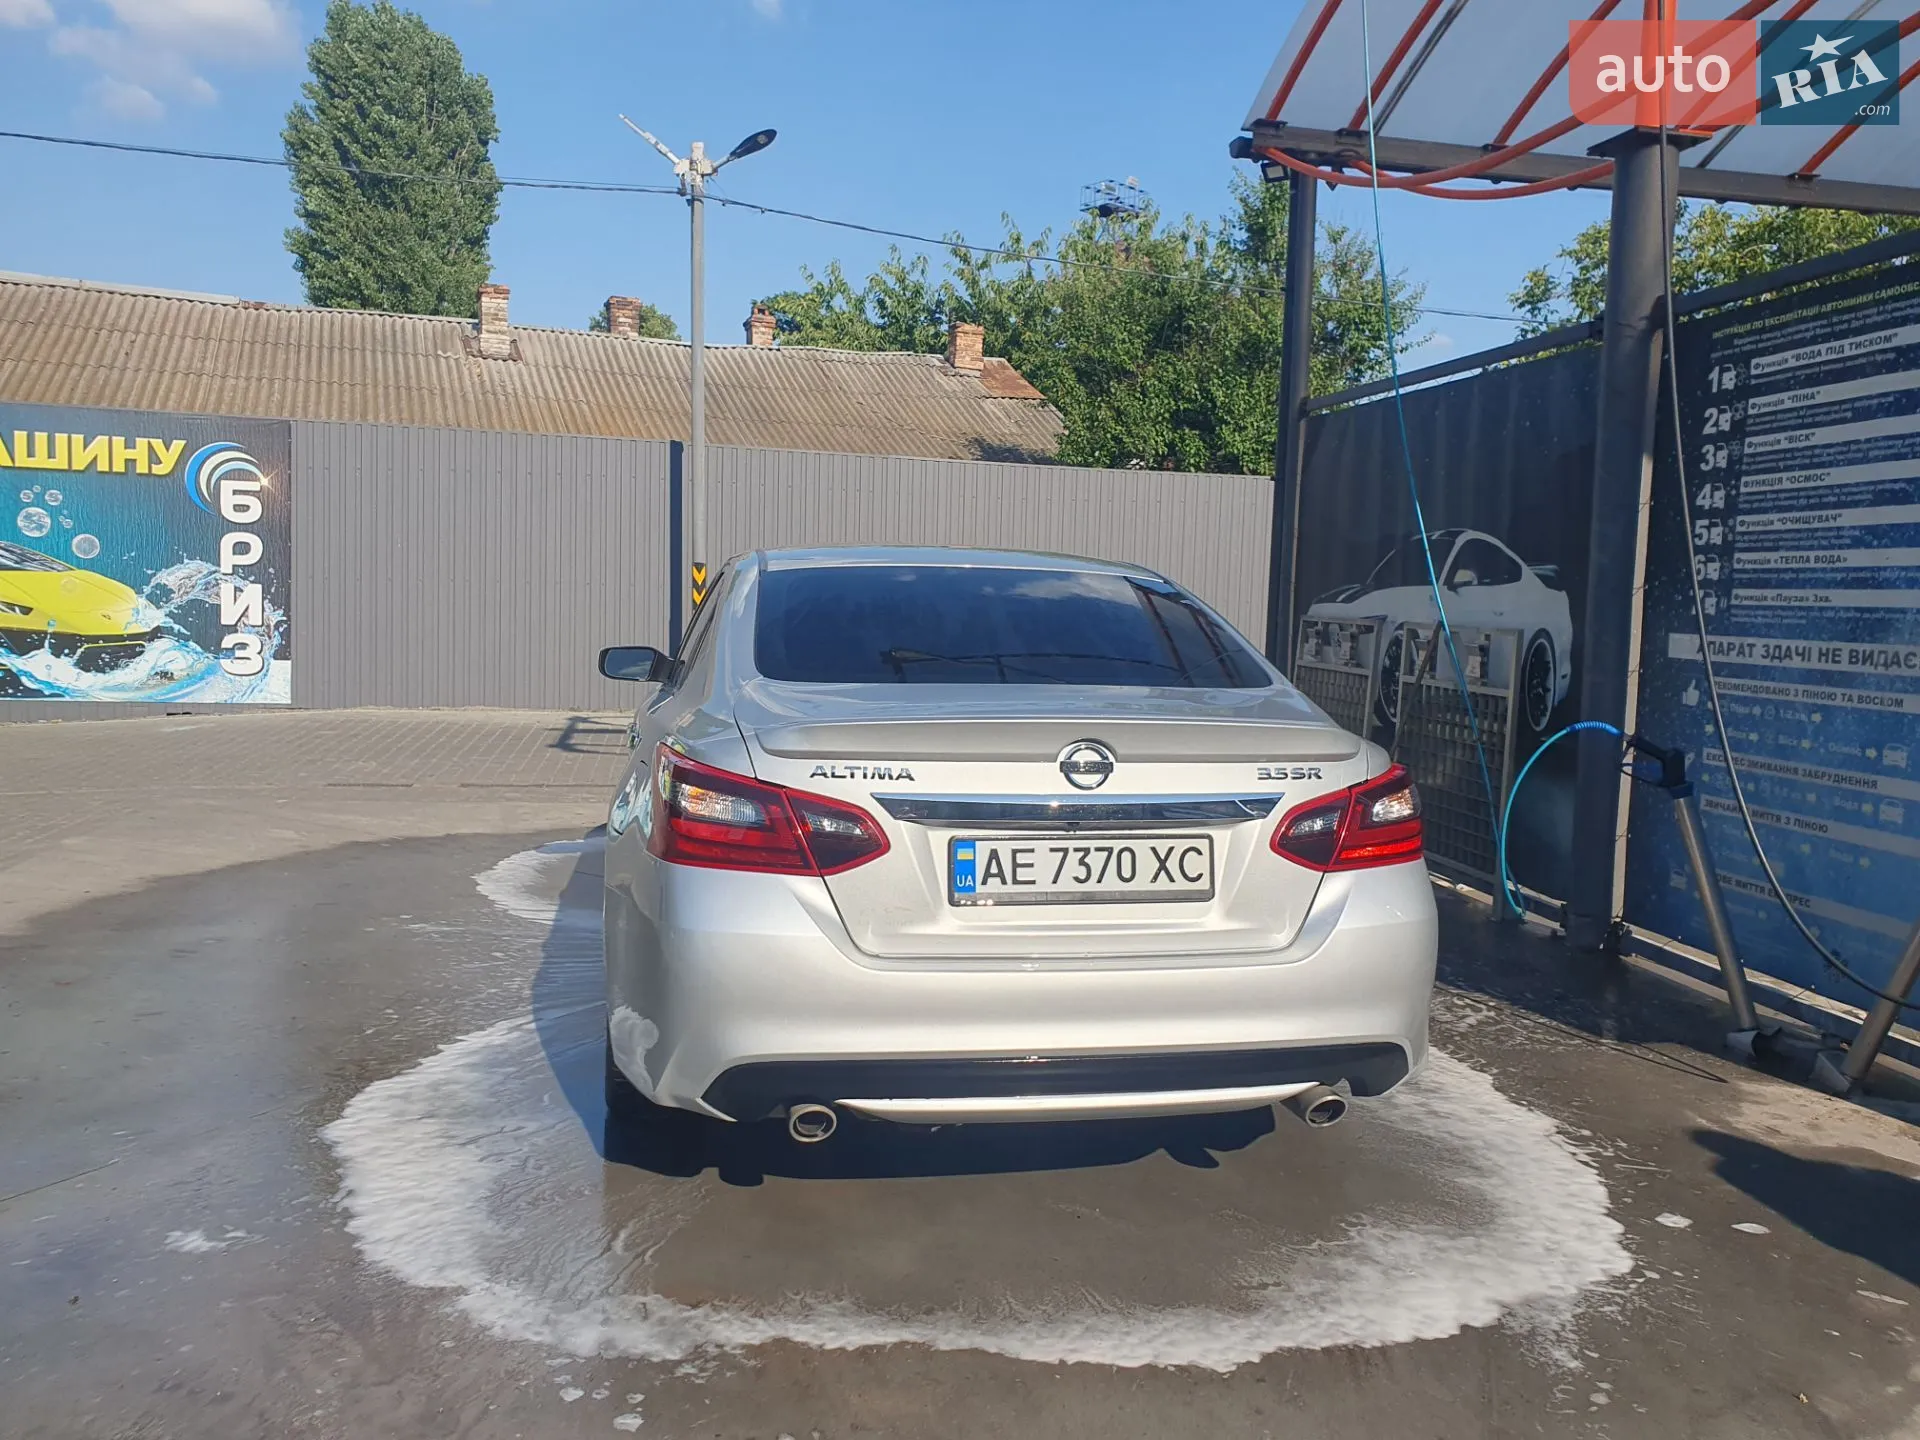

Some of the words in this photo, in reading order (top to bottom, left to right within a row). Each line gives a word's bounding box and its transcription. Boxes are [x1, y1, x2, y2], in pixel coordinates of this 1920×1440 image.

[1753, 356, 1789, 372] Функція
[1825, 344, 1845, 357] ПІД
[1750, 398, 1785, 413] Функція
[1702, 408, 1718, 435] 2
[1747, 437, 1781, 452] Функція
[1700, 444, 1715, 471] 3
[1743, 476, 1783, 489] ФУНКЦІЯ
[1696, 483, 1712, 510] 4
[1694, 519, 1709, 546] 5
[1738, 517, 1774, 530] Функція
[1735, 556, 1771, 567] Функція
[220, 479, 264, 676] БРИЗ
[1761, 643, 1811, 663] ЗДАЧІ
[1818, 647, 1842, 664] НЕ
[1801, 688, 1837, 702] ПІНОЮ
[1840, 692, 1854, 704] ТА
[1706, 751, 1746, 767] ЕКСРЕС
[809, 764, 916, 782] ALTIMA
[981, 848, 1036, 885] AE
[1050, 845, 1137, 885] 7370
[1150, 845, 1204, 883] XC
[956, 874, 974, 888] UA
